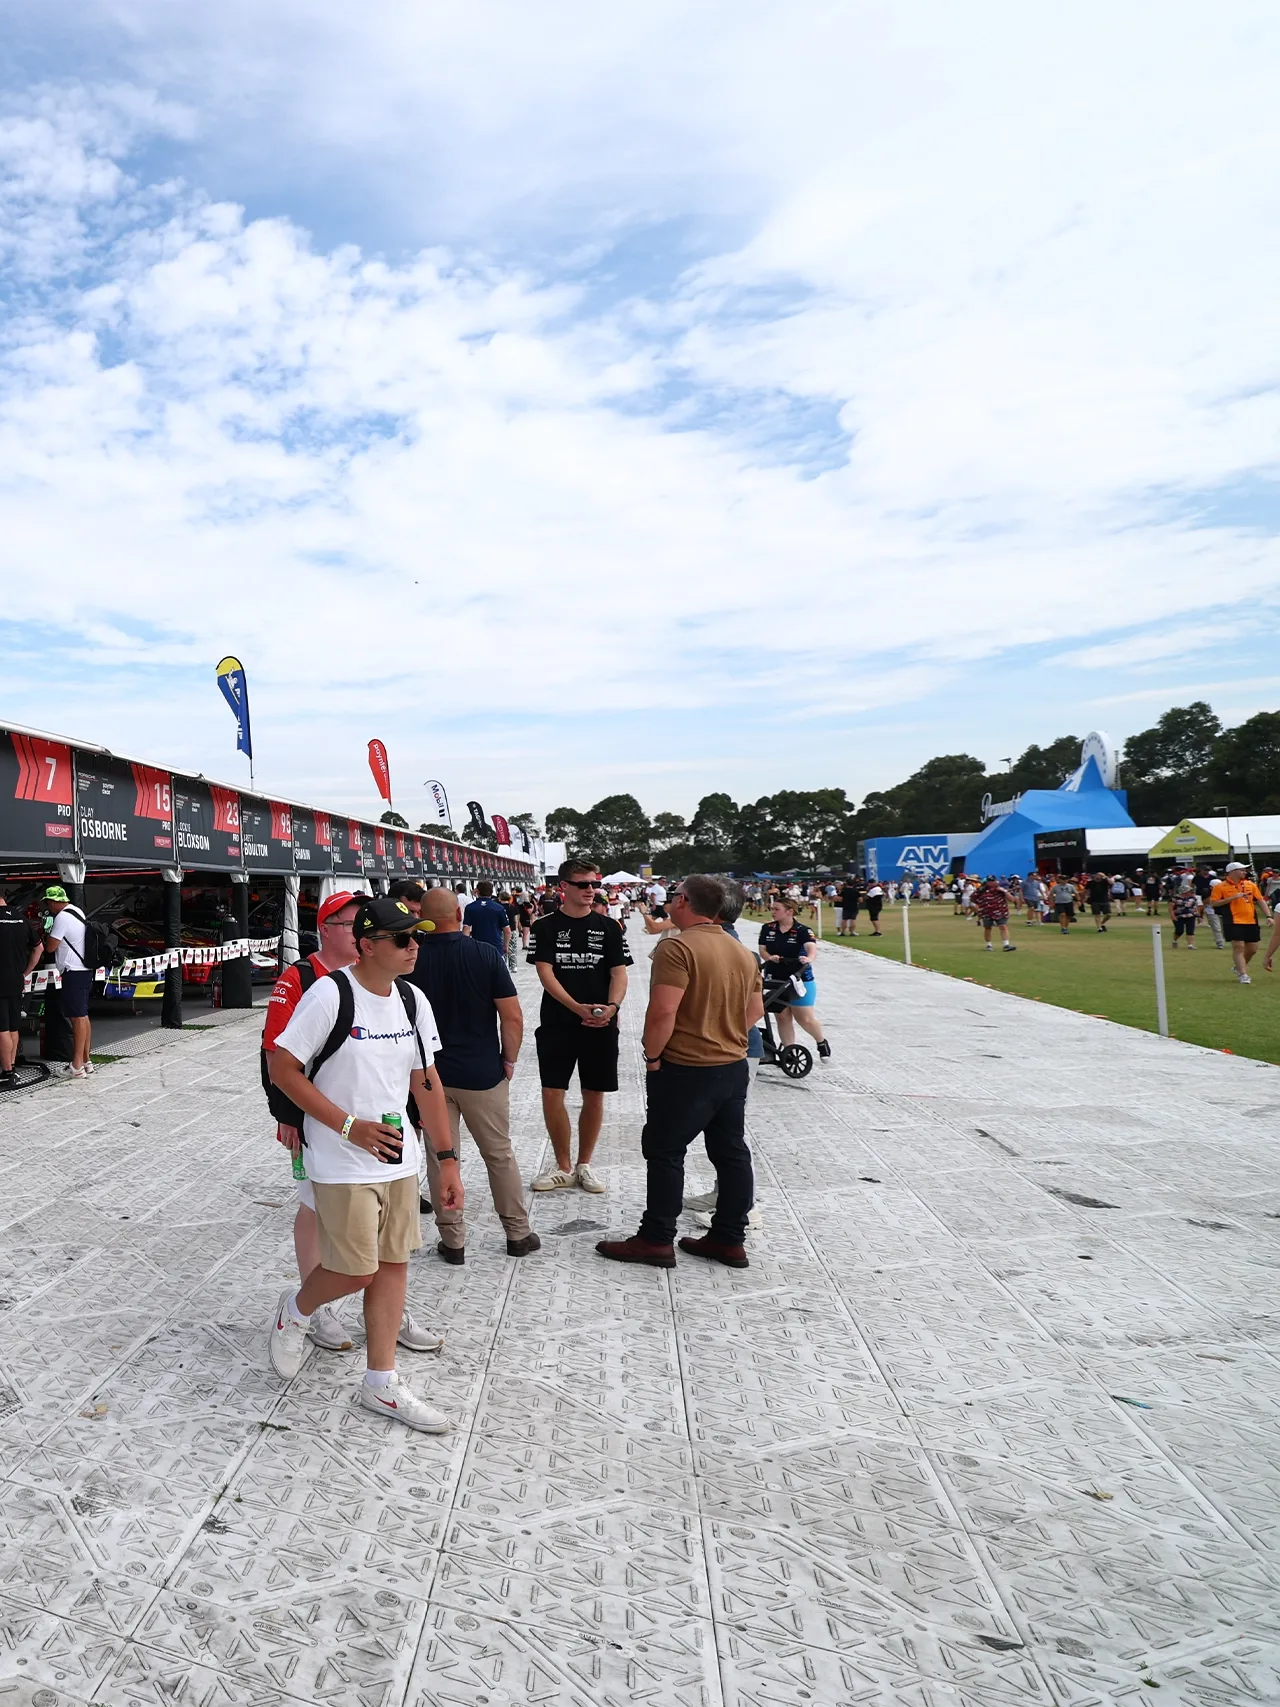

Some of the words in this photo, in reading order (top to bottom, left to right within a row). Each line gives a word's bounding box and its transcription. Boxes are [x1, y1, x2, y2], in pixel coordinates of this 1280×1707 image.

[373, 743, 387, 773] paynter
[45, 757, 57, 791] 7
[154, 782, 171, 812] 15
[431, 784, 445, 808] Mobil
[57, 804, 71, 817] PRO
[80, 805, 95, 818] CLAY
[226, 801, 239, 826] 23
[81, 818, 128, 841] OSBORNE
[177, 832, 210, 851] BLOXSOM
[243, 842, 269, 857] BOULTON
[896, 845, 949, 867] AM
[555, 952, 605, 965] FENDT
[349, 1026, 418, 1045] Champio
